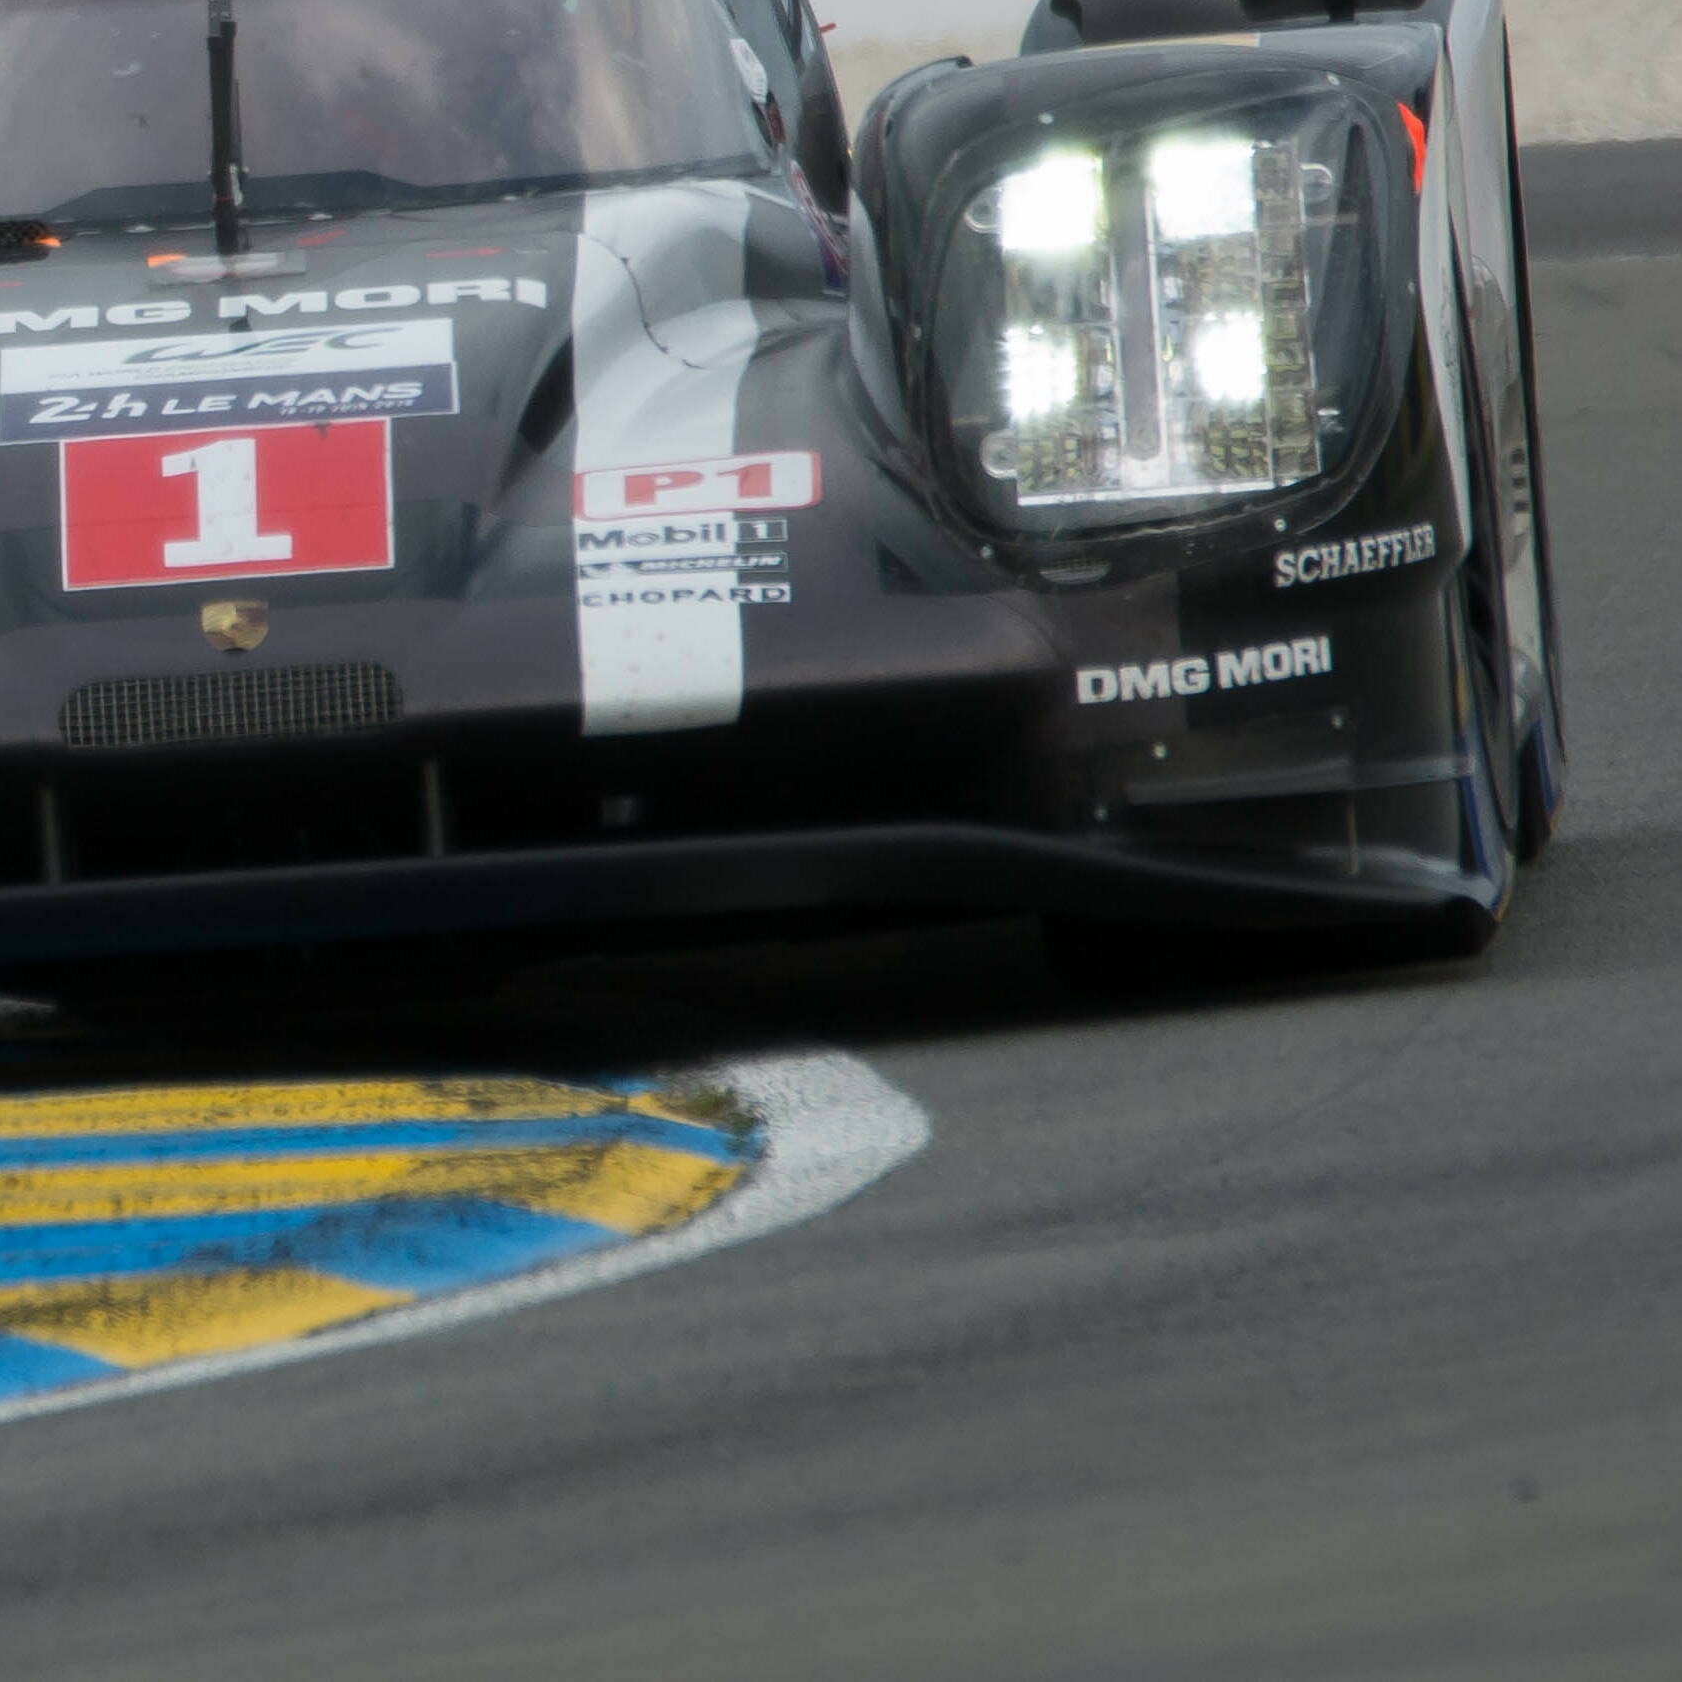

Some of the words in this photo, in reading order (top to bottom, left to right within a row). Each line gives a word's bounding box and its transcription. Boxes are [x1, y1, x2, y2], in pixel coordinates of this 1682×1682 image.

[219, 277, 547, 318] MORI
[161, 394, 238, 416] LE
[247, 382, 423, 411] MANS
[161, 437, 292, 568] 1
[624, 462, 772, 508] P1
[1275, 524, 1436, 588] SCHAEFFLER
[582, 587, 786, 607] CHOPARD
[1076, 658, 1211, 704] DMG
[1215, 635, 1334, 690] MORI
